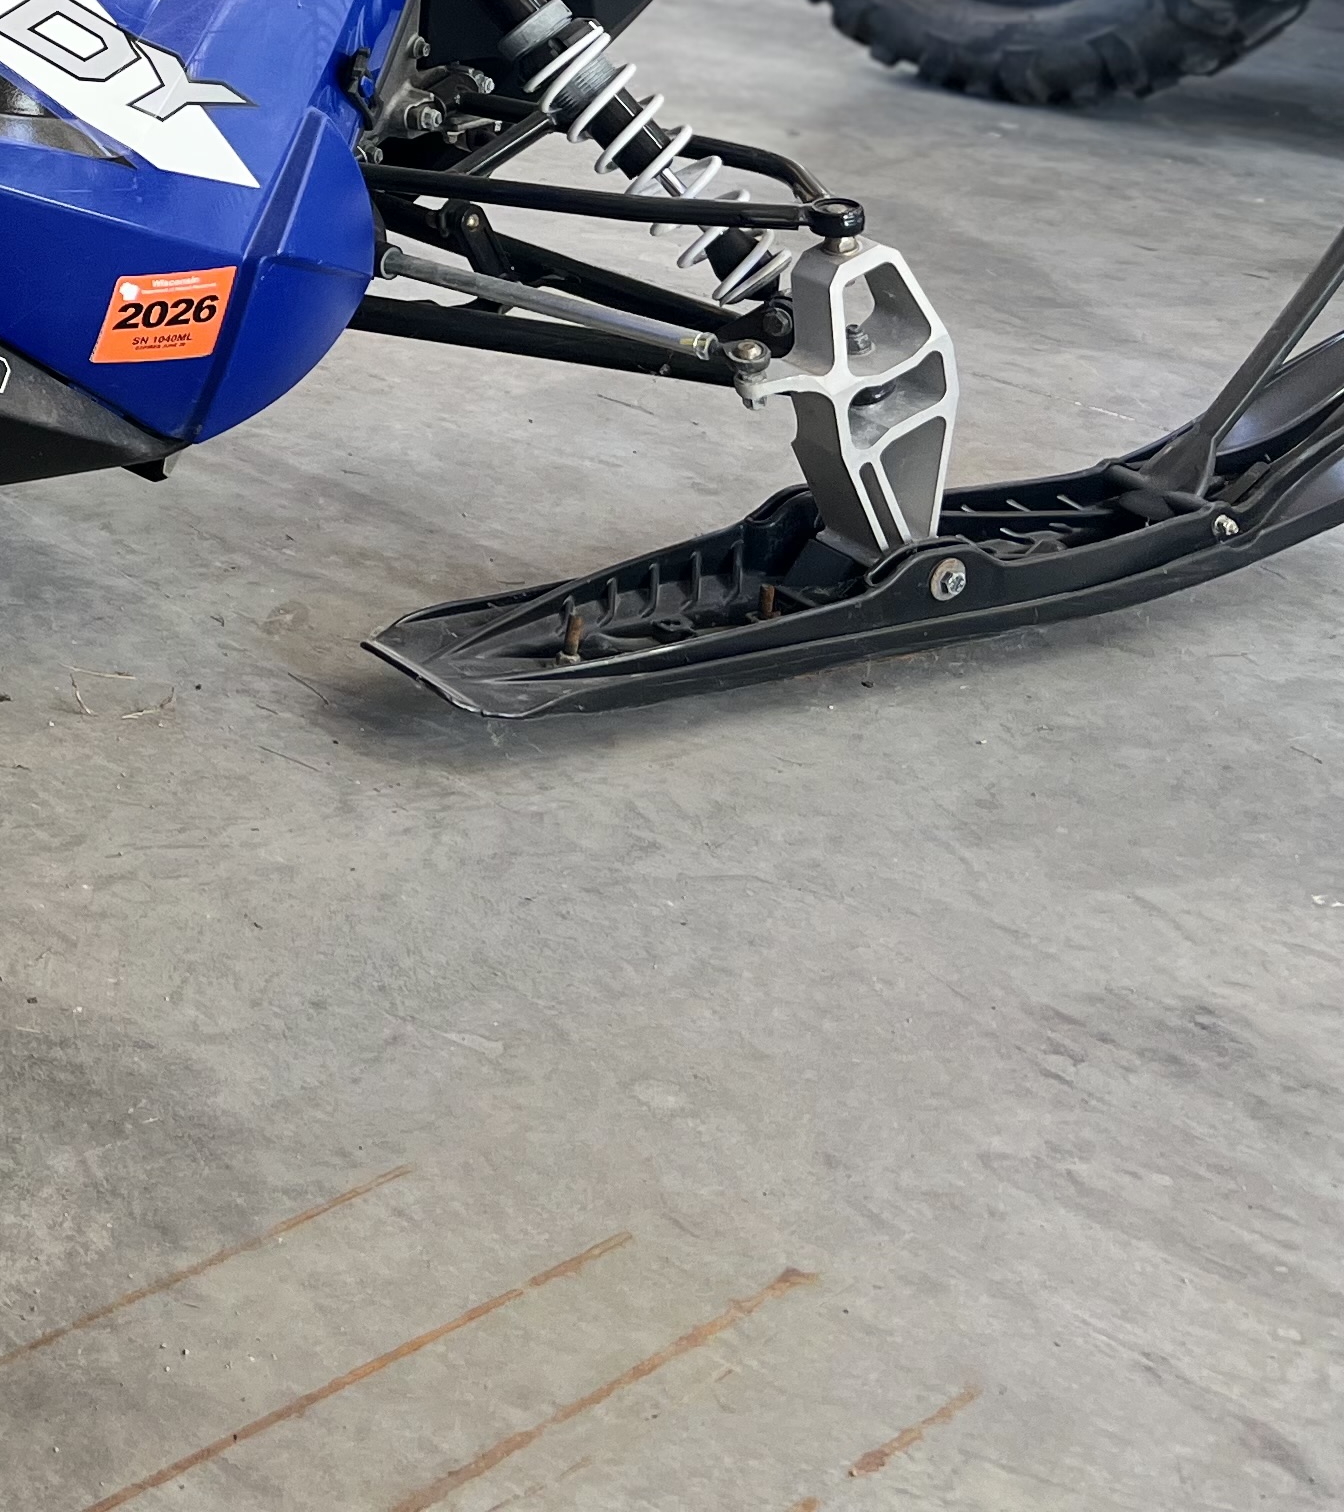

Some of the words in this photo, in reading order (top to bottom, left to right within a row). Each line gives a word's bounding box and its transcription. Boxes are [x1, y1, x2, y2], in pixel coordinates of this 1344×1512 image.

[152, 276, 200, 287] Wisconsin
[112, 294, 220, 331] 2026
[132, 336, 149, 346] SN
